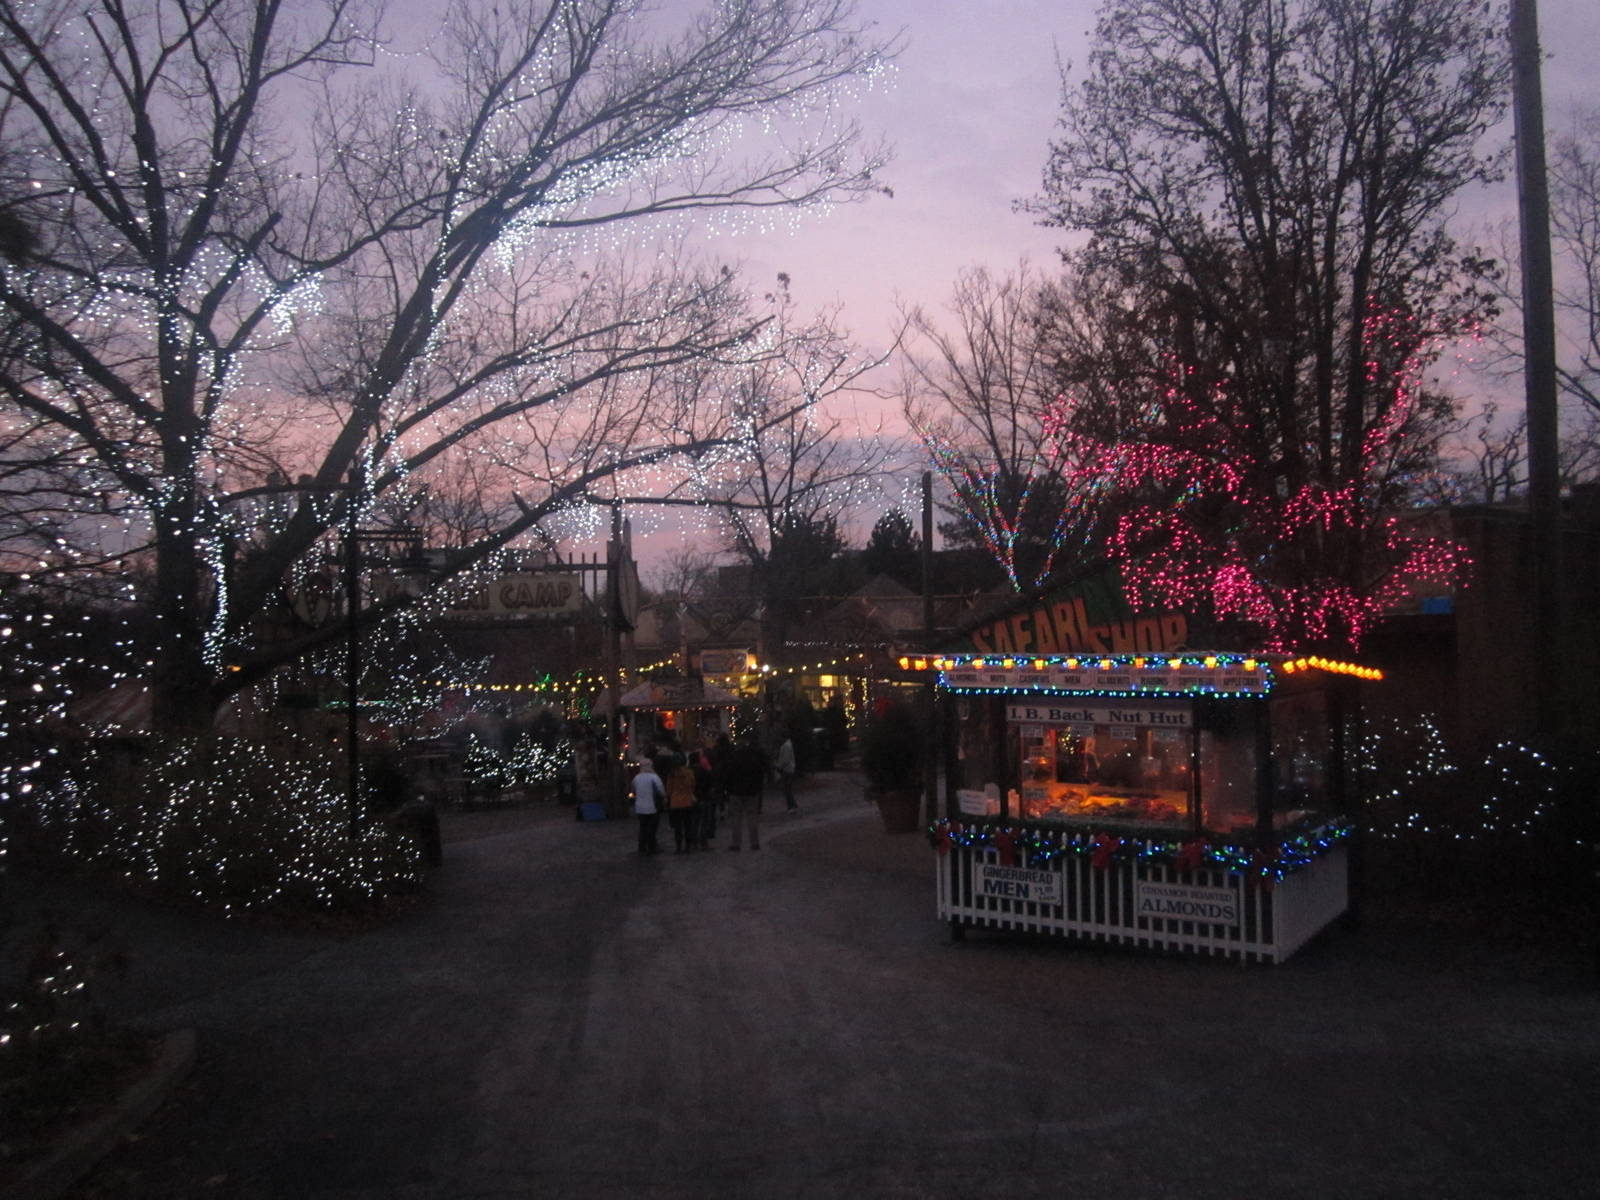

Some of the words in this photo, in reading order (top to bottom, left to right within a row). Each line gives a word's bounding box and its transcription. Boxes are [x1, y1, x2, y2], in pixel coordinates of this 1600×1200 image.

[499, 582, 573, 608] CAMP
[971, 597, 1088, 654] SAFARI
[1088, 613, 1188, 654] SHOP
[1025, 708, 1043, 720] B.
[1048, 708, 1095, 722] Back
[1108, 710, 1142, 723] Nut
[1148, 711, 1186, 724] Hut
[983, 865, 1053, 890] GINGERBREAD
[984, 879, 1029, 899] MEN
[1142, 886, 1189, 898] CINNAMON
[1142, 898, 1234, 920] ALMONDS
